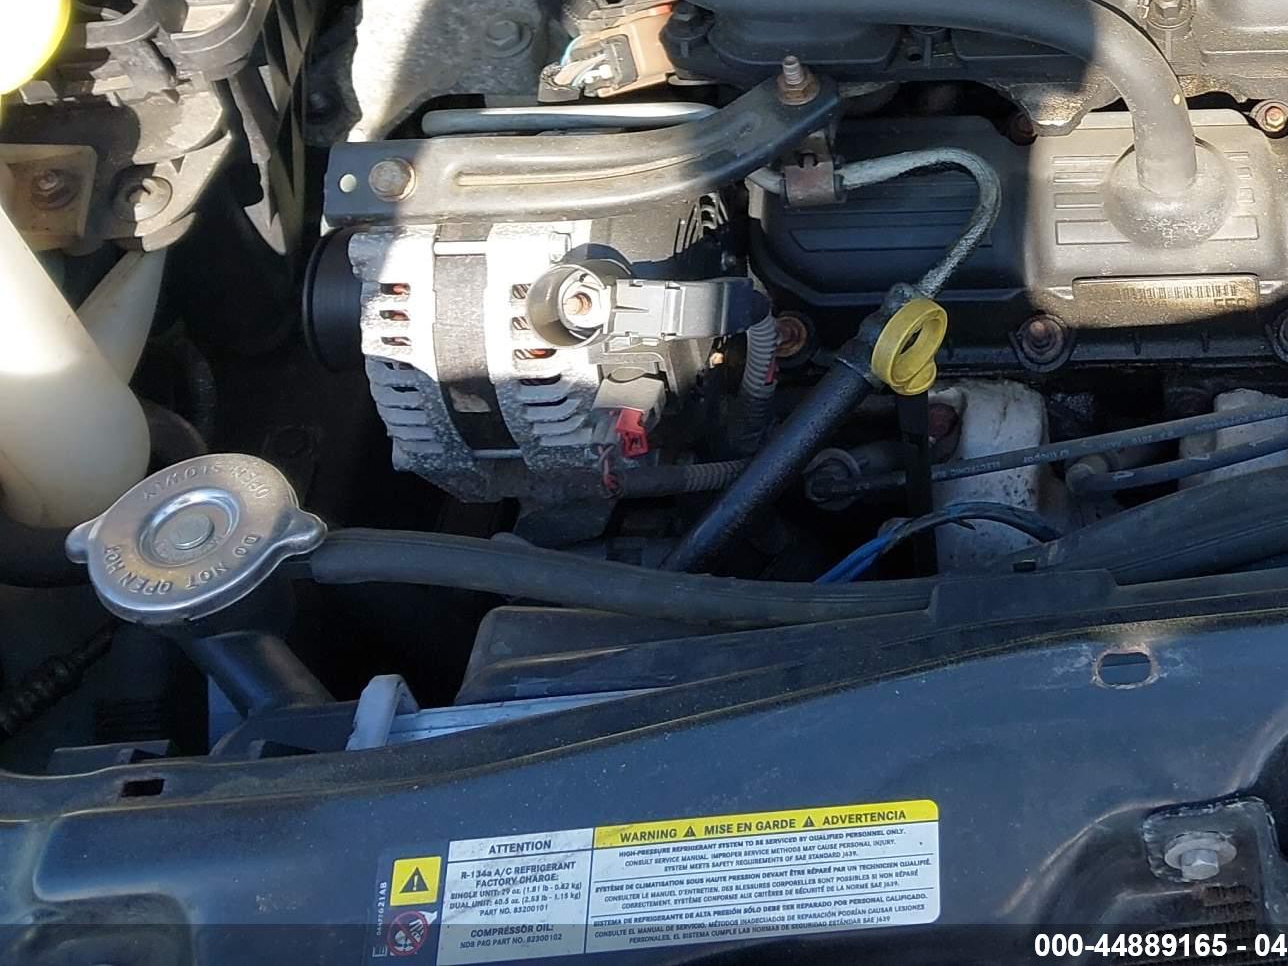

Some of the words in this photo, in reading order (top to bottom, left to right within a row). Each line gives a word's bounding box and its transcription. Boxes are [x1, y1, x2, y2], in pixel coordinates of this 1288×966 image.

[230, 464, 270, 499] OPEN
[232, 534, 261, 558] DO
[103, 544, 126, 574] HOT
[121, 570, 174, 595] OPEN
[184, 562, 229, 592] NOT
[620, 829, 676, 843] WARNING
[704, 823, 733, 835] MISE
[737, 822, 752, 832] EN
[756, 818, 795, 831] GARDE
[822, 810, 906, 825] ADVERTENCIA
[489, 840, 551, 855] ATTENTION
[619, 847, 670, 857] HIGH-PRESSURE
[461, 869, 492, 879] R-134a
[494, 867, 512, 876] A/C
[514, 861, 576, 875] REFRIGERANT
[476, 877, 517, 888] FACTORY
[519, 873, 559, 885] CHARGE:
[451, 891, 477, 899] SINGLE
[450, 901, 471, 909] DUAL
[480, 908, 497, 916] PART
[471, 925, 530, 938] COMPRESSOR
[533, 924, 553, 933] OIL:
[493, 938, 511, 946] PART
